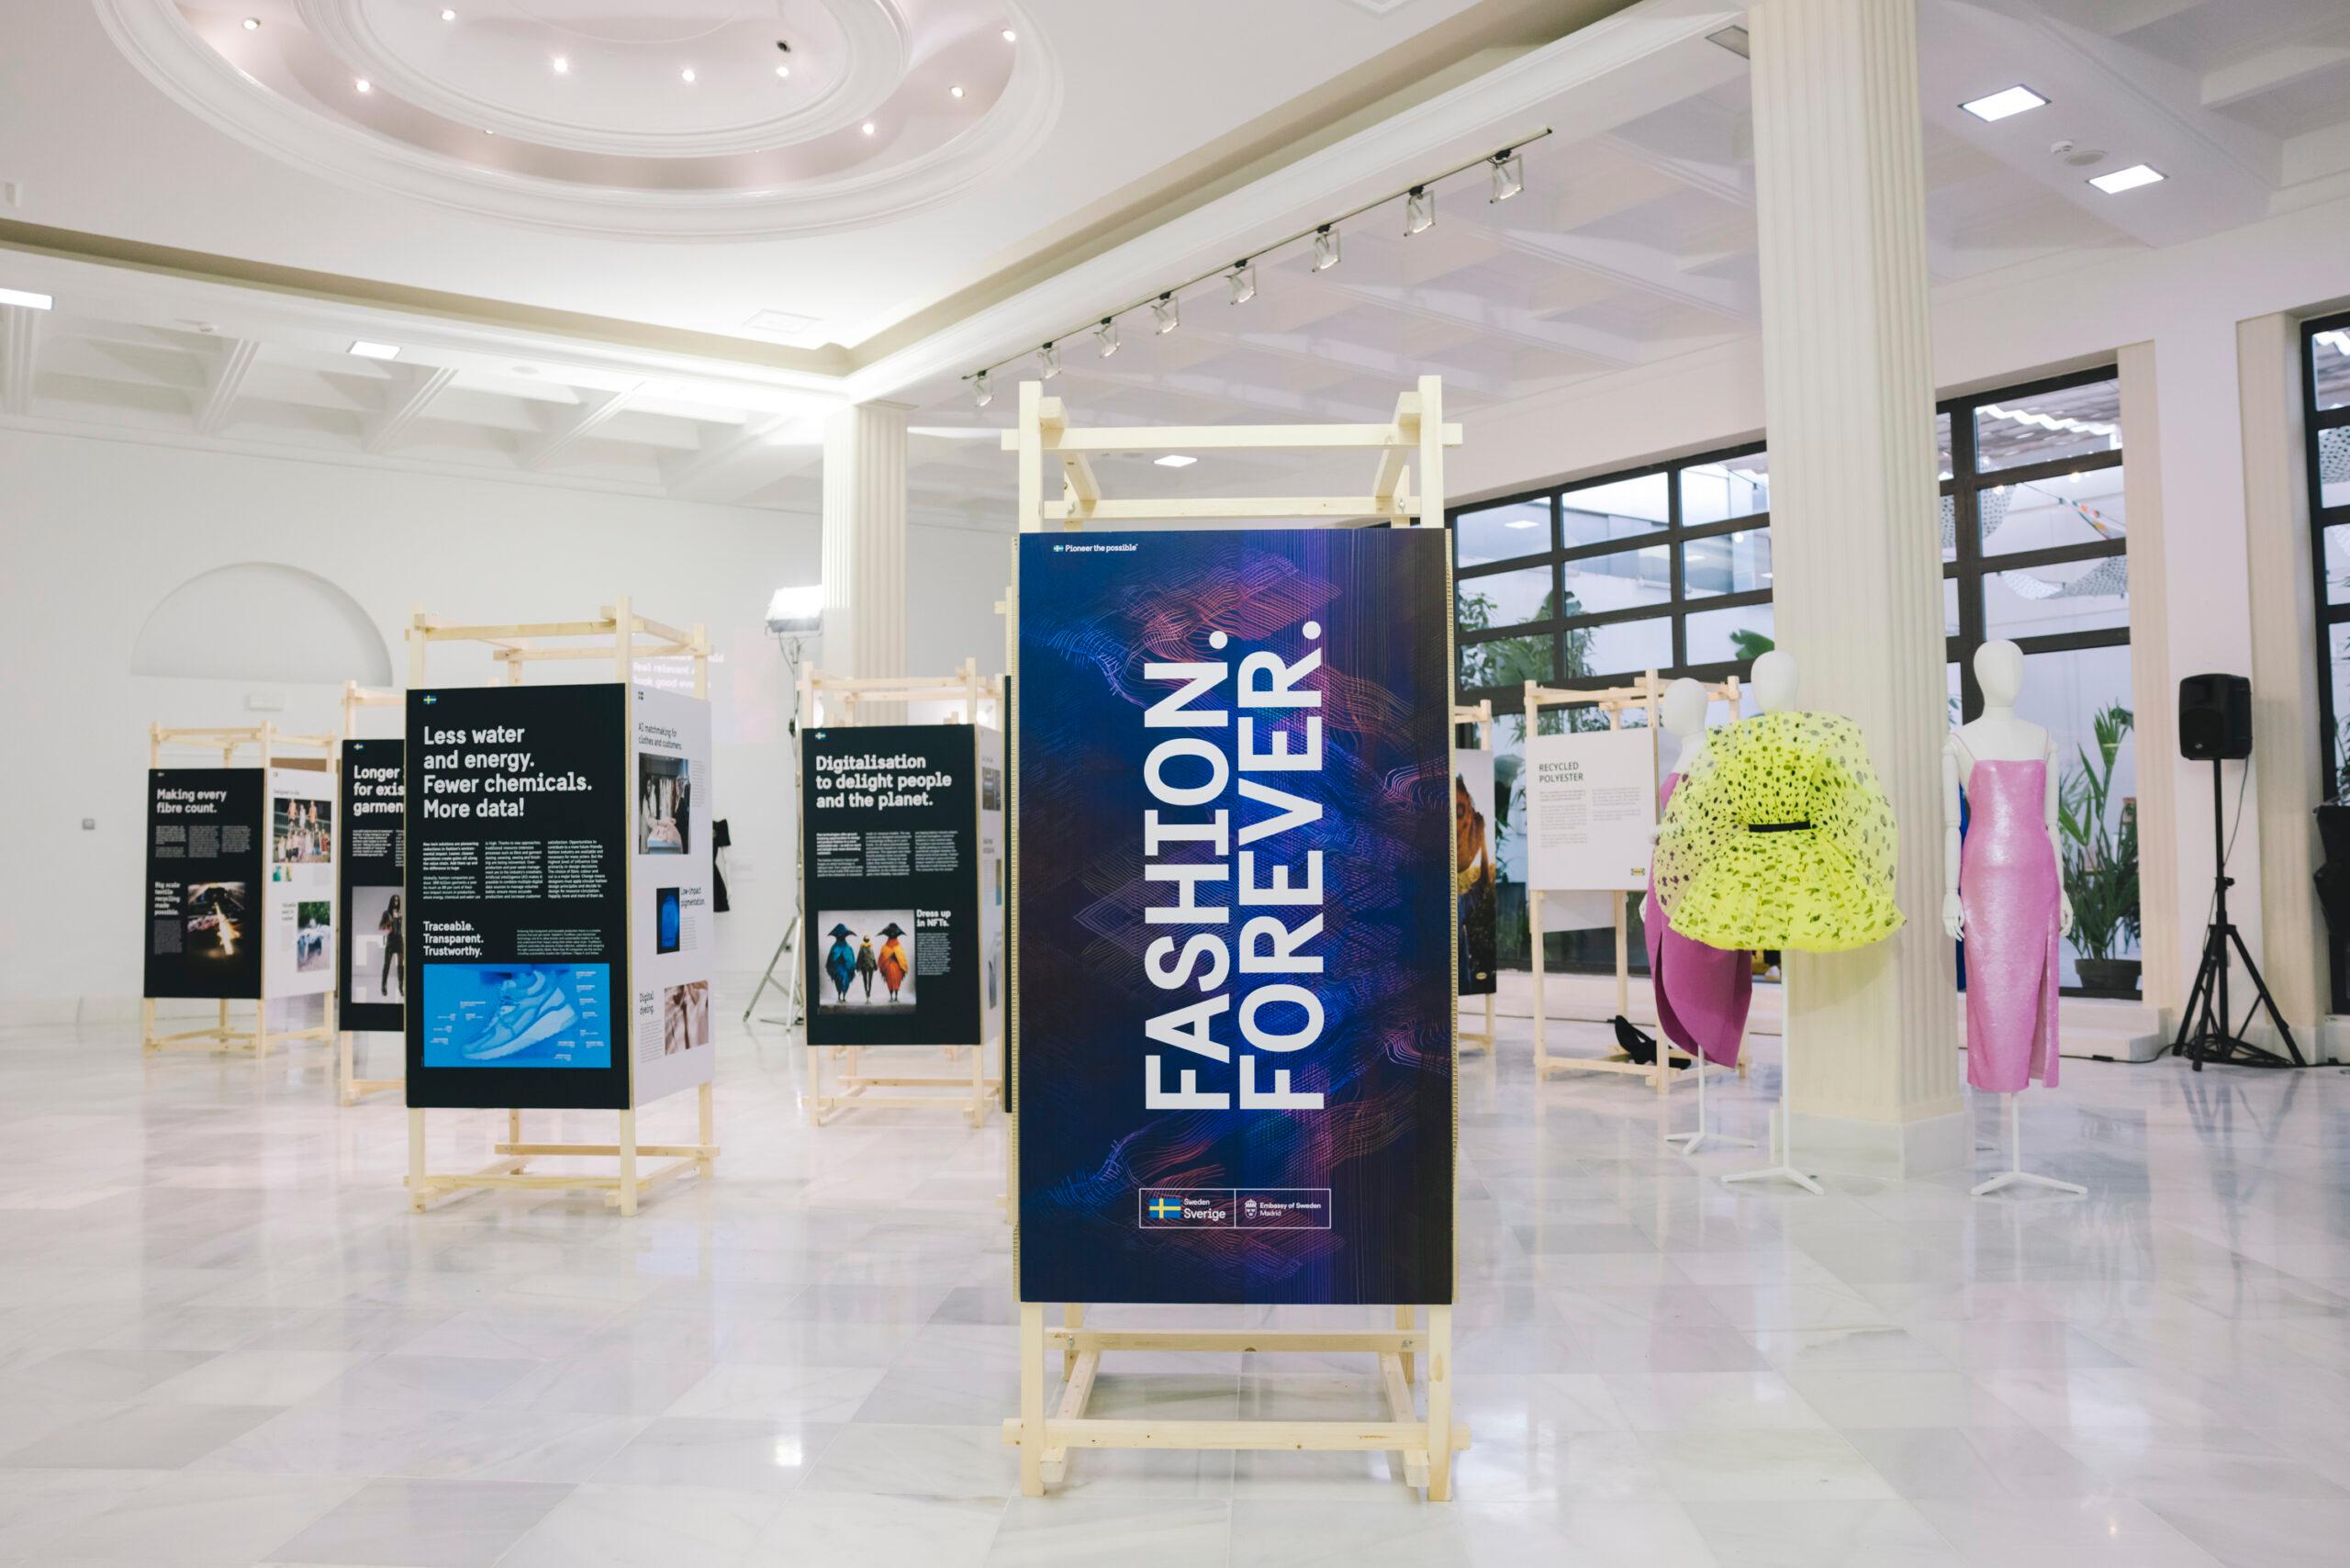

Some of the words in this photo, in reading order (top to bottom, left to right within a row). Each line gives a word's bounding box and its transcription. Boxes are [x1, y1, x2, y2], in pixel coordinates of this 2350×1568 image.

[425, 726, 466, 745] Less
[472, 726, 524, 744] water
[424, 750, 458, 769] and
[464, 753, 534, 772] energy.
[816, 754, 925, 775] Digitalisation
[1539, 762, 1579, 771] RECYCLED
[354, 765, 400, 782] Longer
[1539, 773, 1583, 782] POLYESTER
[424, 775, 479, 793] Fewer
[485, 771, 592, 792] chemicals.
[816, 776, 832, 790] to
[834, 772, 893, 792] delight
[898, 771, 952, 791] people
[157, 789, 195, 802] Making
[197, 791, 227, 801] every
[353, 782, 373, 796] for
[157, 802, 182, 813] fibre
[185, 801, 217, 812] count.
[424, 800, 470, 818] More
[476, 798, 524, 817] data!
[816, 792, 844, 808] and
[848, 791, 874, 807] the
[878, 791, 933, 811] planet.
[353, 801, 404, 817] garmen
[1144, 631, 1230, 1109] FASHION.
[1237, 621, 1325, 1109] FOREVER.
[916, 910, 938, 919] Dress
[939, 911, 951, 921] up
[927, 917, 949, 926] NFTs.
[423, 921, 474, 931] Traceable.
[423, 934, 484, 946] Transparent.
[423, 945, 482, 958] Trustworthy.
[1260, 1203, 1287, 1211] Embassy
[1184, 1208, 1225, 1221] Sverige
